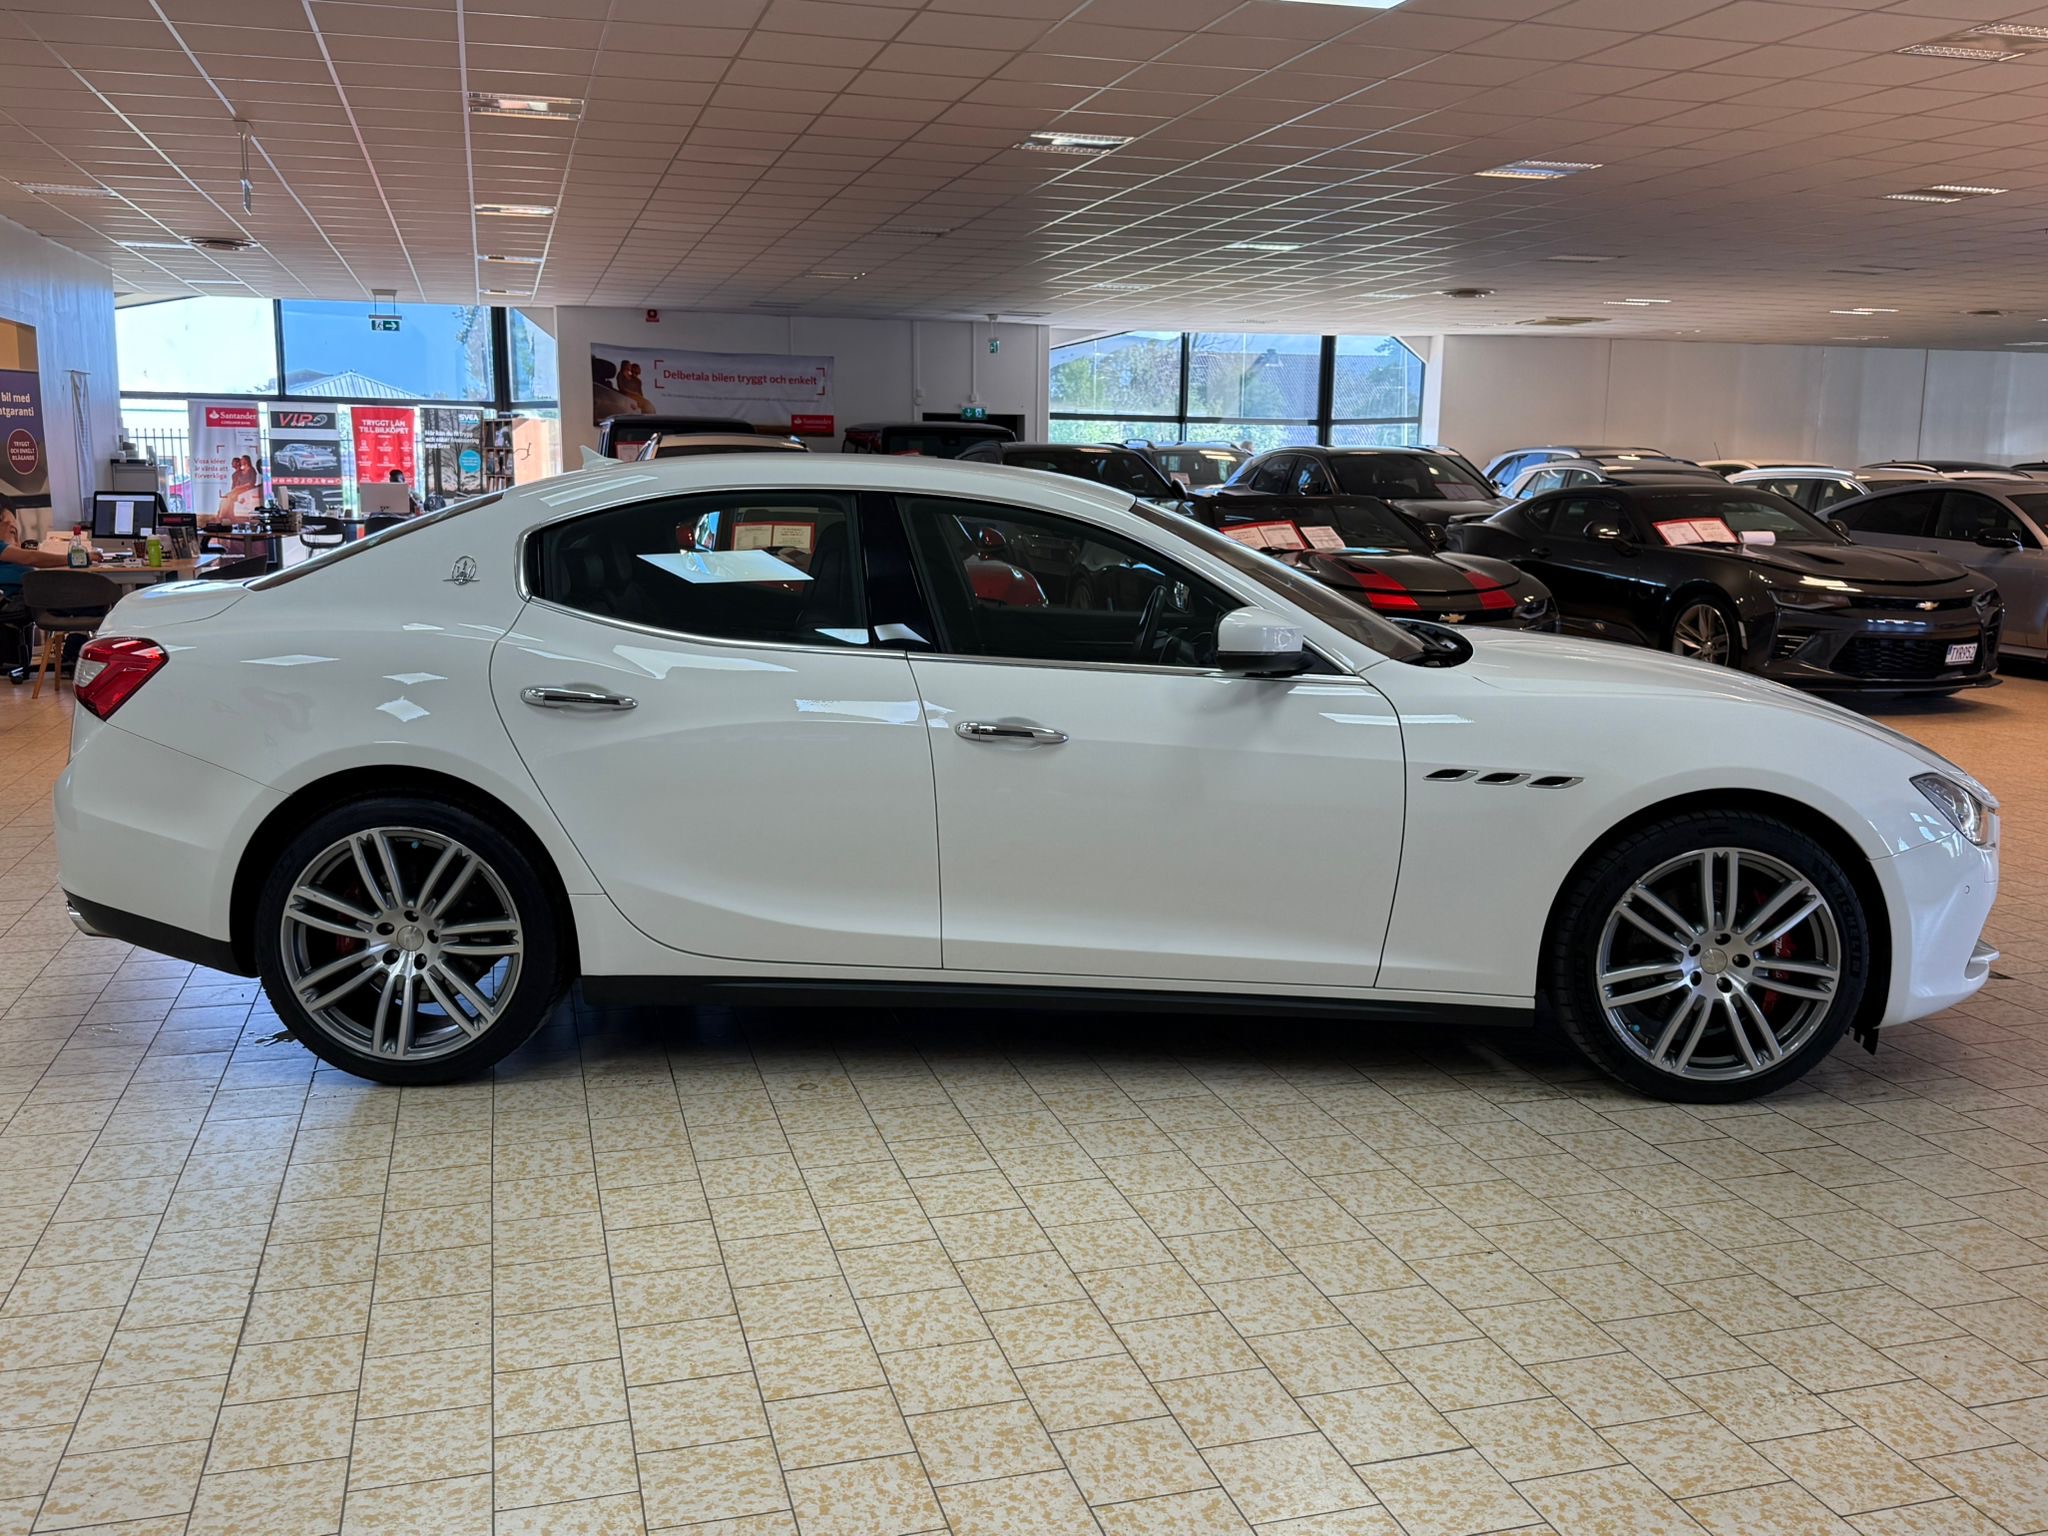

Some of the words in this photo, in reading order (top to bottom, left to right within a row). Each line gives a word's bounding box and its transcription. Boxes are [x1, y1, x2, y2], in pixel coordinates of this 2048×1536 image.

[663, 370, 710, 382] Delbetala
[712, 373, 735, 383] bilen
[737, 375, 767, 385] tryggt
[769, 375, 787, 384] och
[788, 376, 817, 385] enkelt
[1, 392, 11, 401] bil
[13, 393, 30, 403] med
[220, 411, 257, 420] Santander
[361, 419, 389, 427] TRYGGT
[390, 419, 406, 427] LÅN
[1828, 881, 1861, 972] MICHELIN
